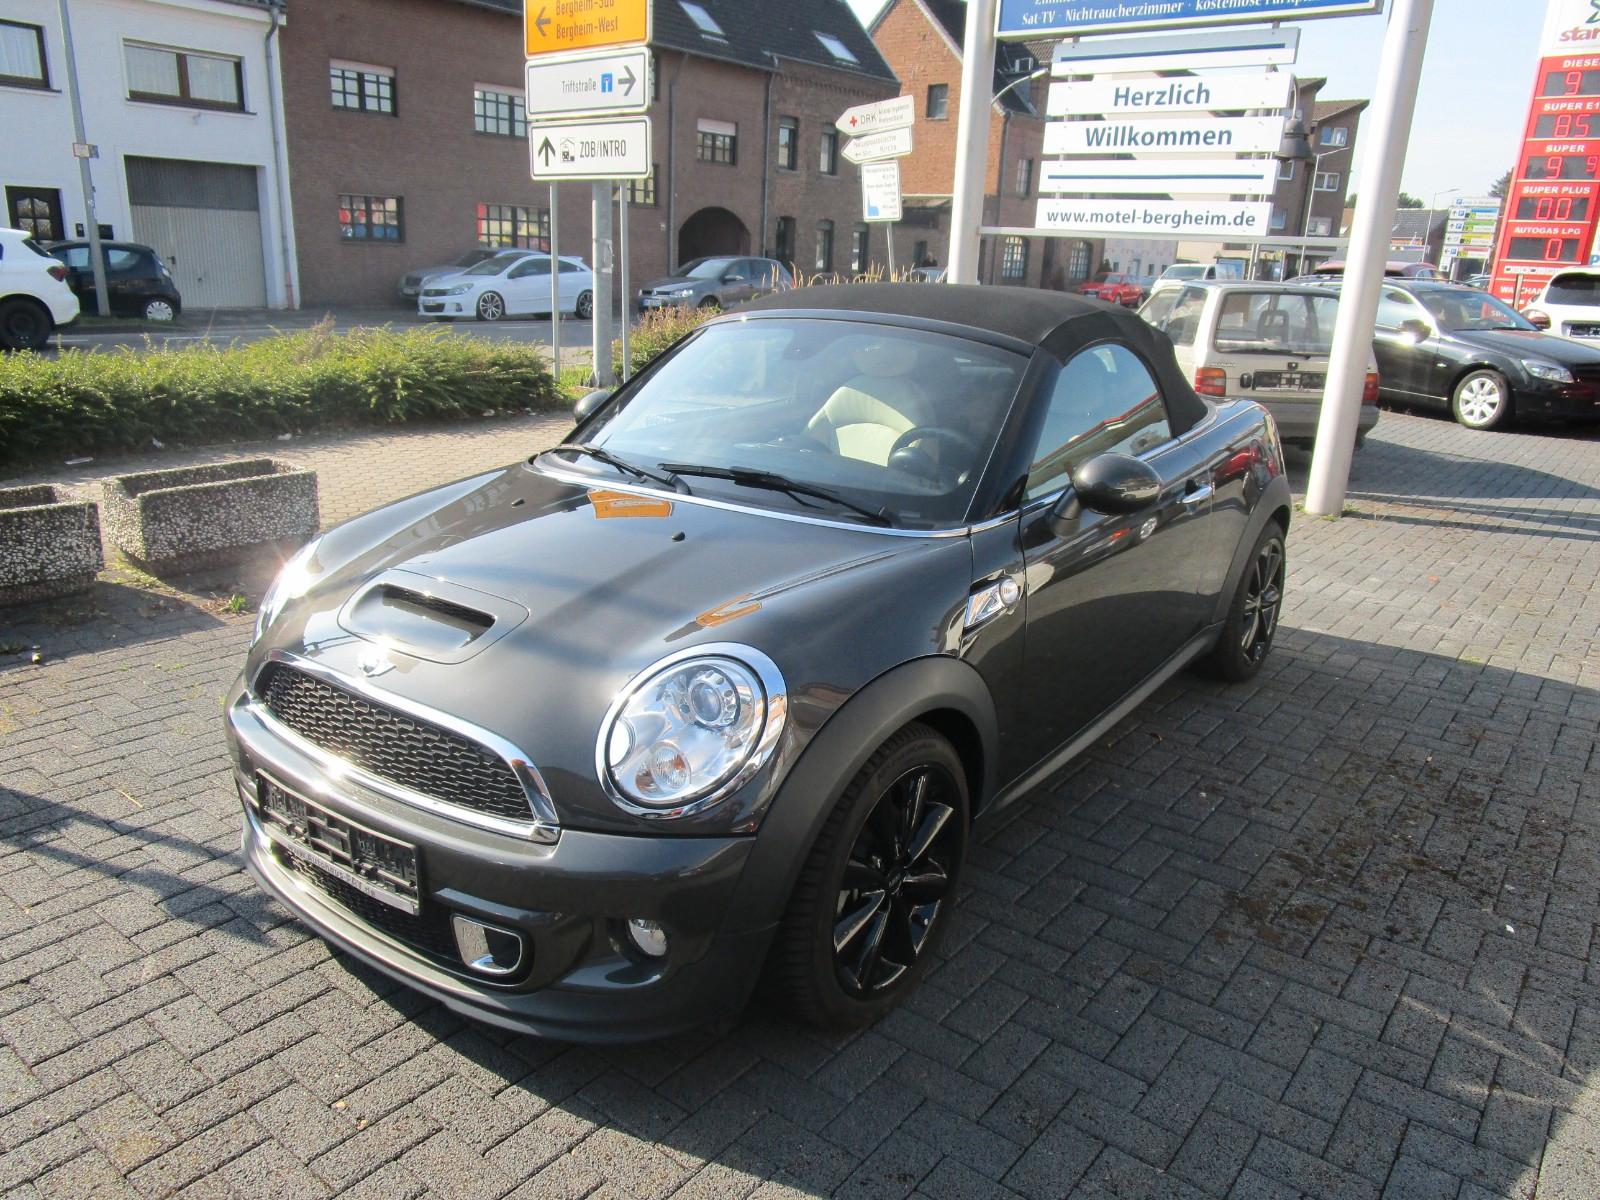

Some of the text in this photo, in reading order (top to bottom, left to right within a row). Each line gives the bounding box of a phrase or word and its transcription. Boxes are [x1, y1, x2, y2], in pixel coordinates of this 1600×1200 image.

[1065, 1, 1184, 22] Nichtraucherzimmer
[556, 16, 618, 41] Bergheim-West
[561, 77, 597, 94] Triftstraße
[1113, 82, 1211, 107] Herzlich
[1543, 102, 1583, 111] SUPER
[1085, 125, 1233, 147] Willkommen
[580, 139, 627, 158] ZOB/INTRO
[1545, 144, 1585, 153] SUPER
[1522, 186, 1591, 194] SUPER PLUS
[1047, 209, 1256, 229] www.motel-bergheim.de
[1514, 226, 1581, 235] AUTOGAS LPG
